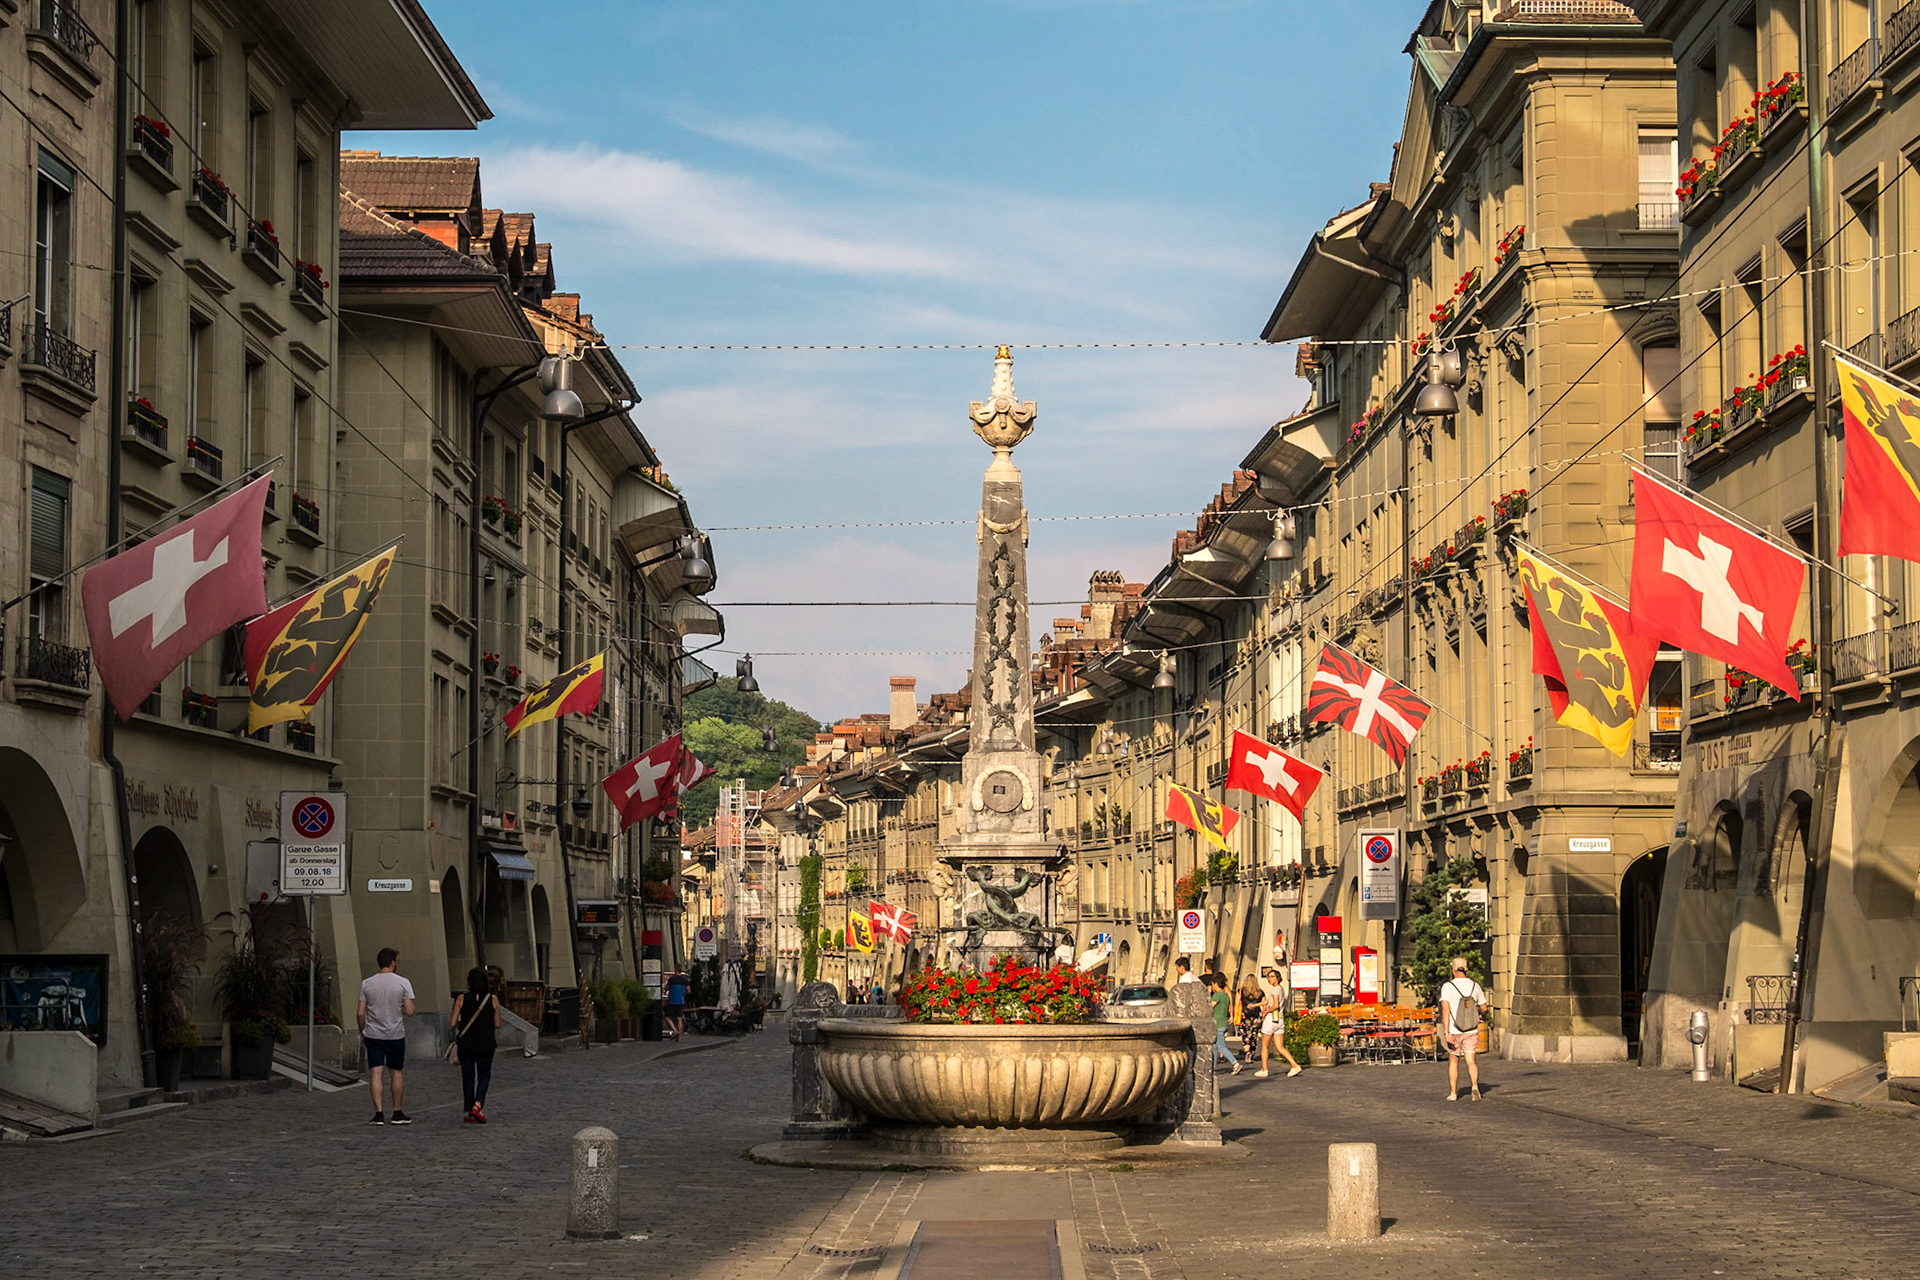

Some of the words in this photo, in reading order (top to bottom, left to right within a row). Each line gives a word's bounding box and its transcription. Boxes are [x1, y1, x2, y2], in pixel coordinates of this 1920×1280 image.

[1700, 740, 1725, 772] POST
[1571, 839, 1609, 850] Kreuzgasse
[287, 845, 312, 854] Ganze
[313, 845, 338, 854] Gasse
[299, 857, 337, 865] Donnerstag
[294, 867, 332, 876] 09.08.18
[301, 878, 325, 887] 12.00
[374, 881, 406, 890] Kreuzgasse
